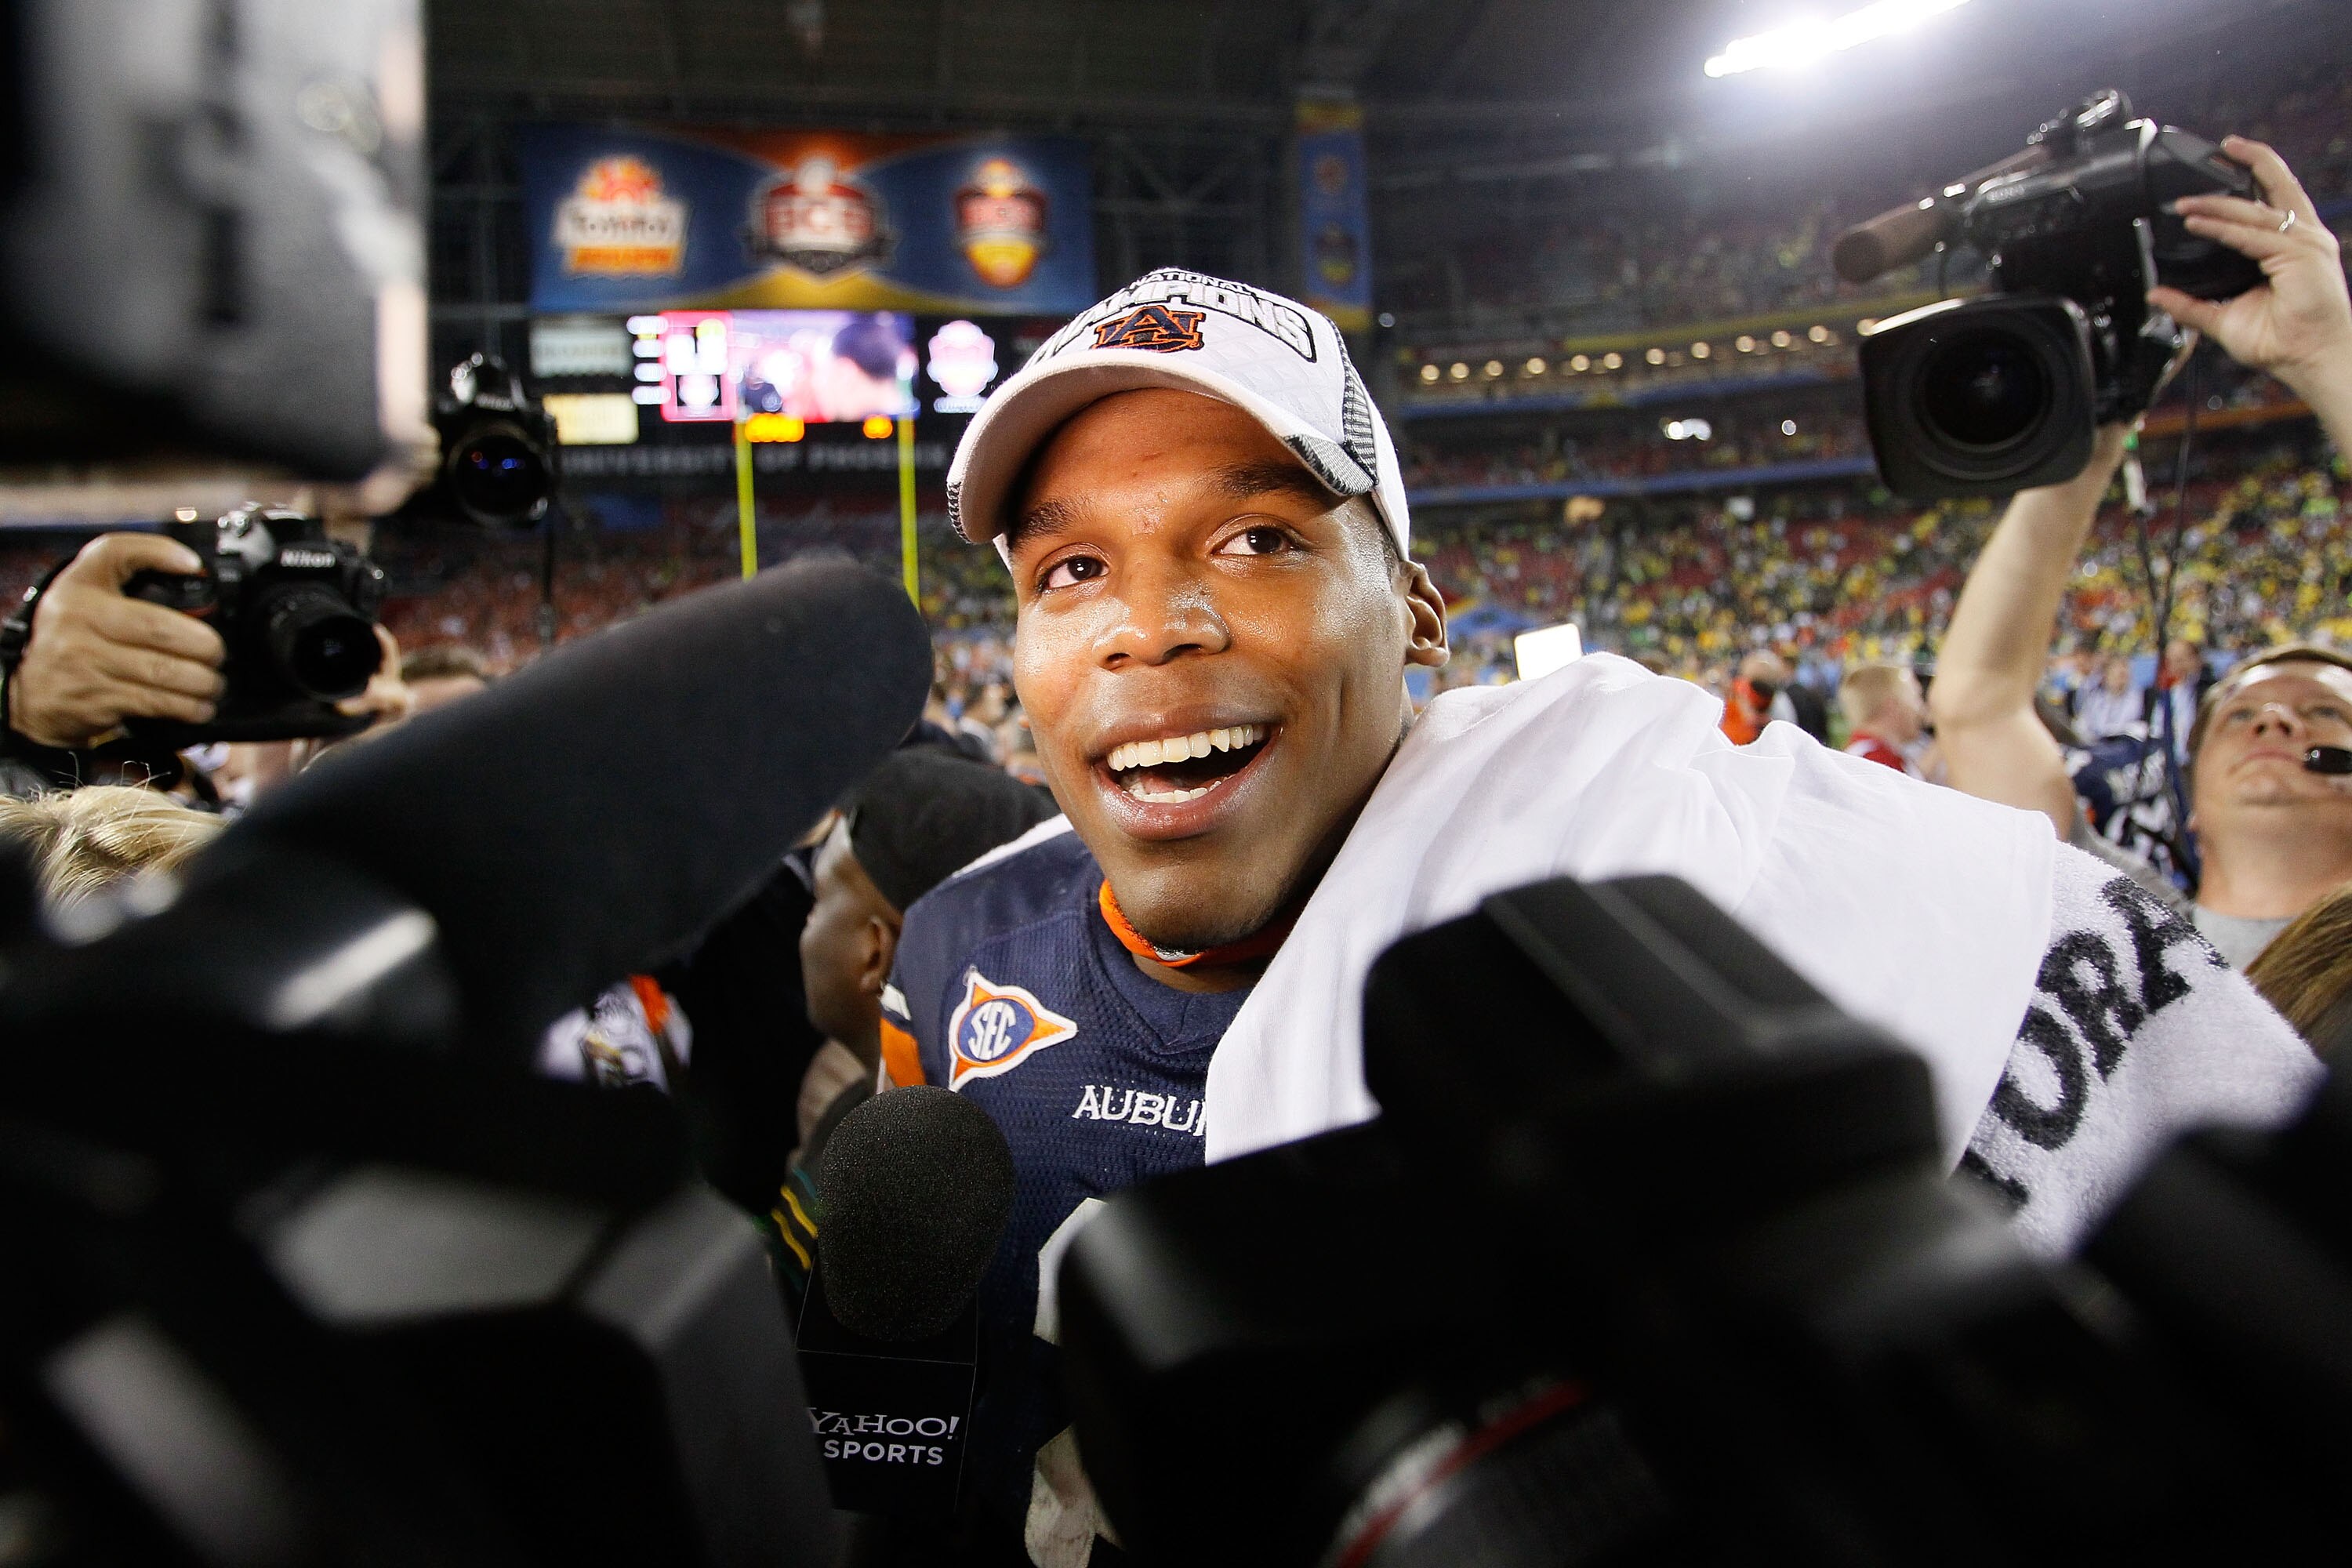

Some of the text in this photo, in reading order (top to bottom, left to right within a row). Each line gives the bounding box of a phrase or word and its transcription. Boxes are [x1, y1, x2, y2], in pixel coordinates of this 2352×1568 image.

[1129, 271, 1253, 296] NATIONAL
[968, 1001, 1017, 1061] SEC
[807, 1406, 960, 1440] YAHOO!
[823, 1439, 944, 1466] SPORTS
